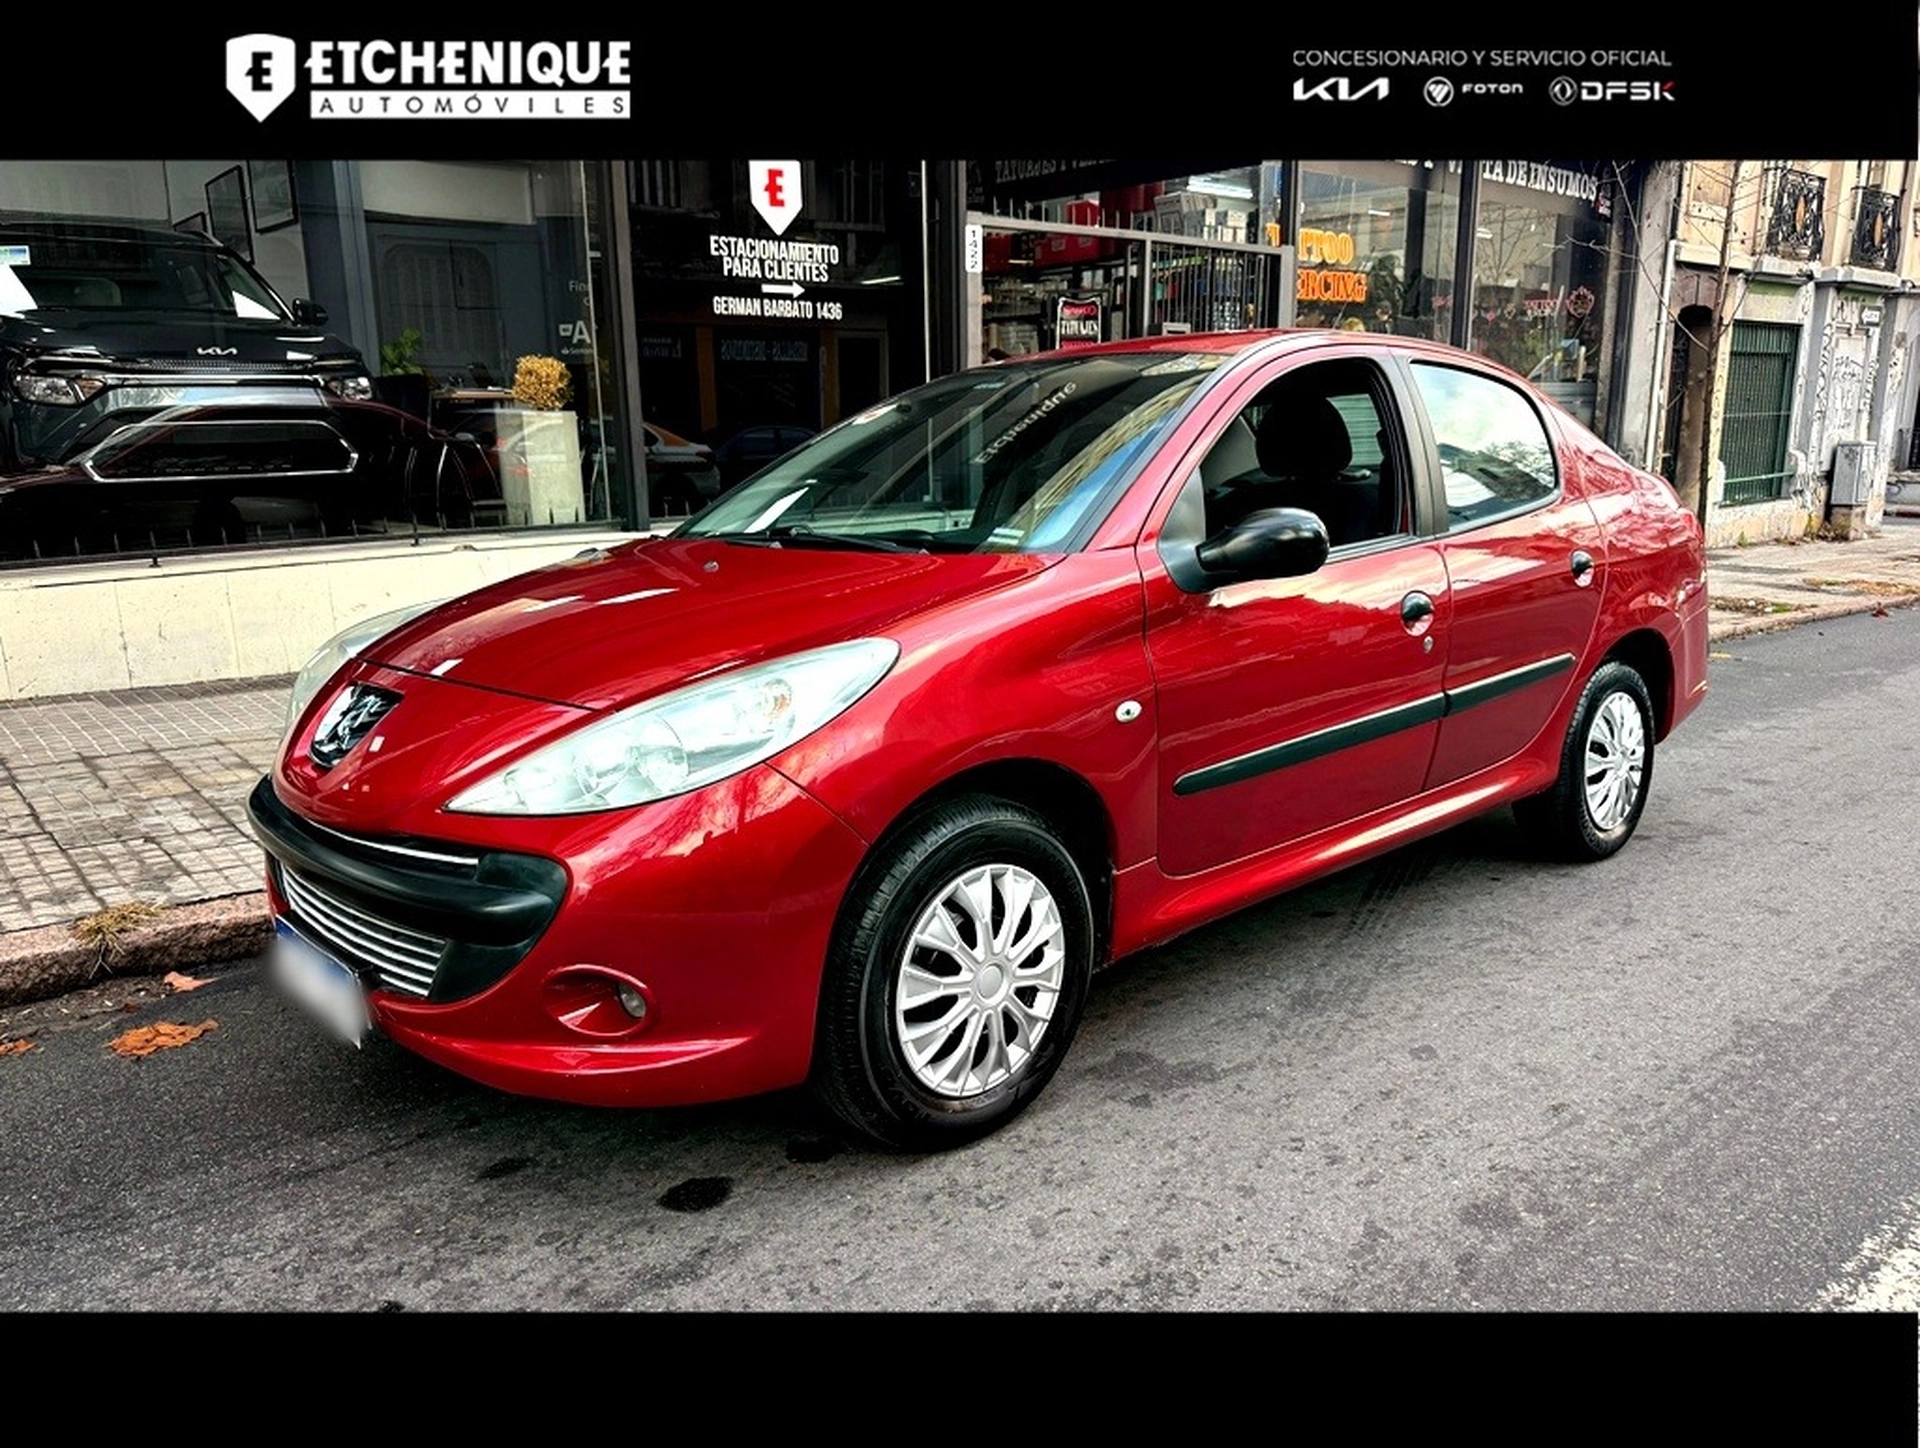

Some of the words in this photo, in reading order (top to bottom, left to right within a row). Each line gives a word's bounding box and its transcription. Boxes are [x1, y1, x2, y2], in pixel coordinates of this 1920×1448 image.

[1505, 161, 1528, 187] DE
[1527, 162, 1598, 202] INSUMOS
[709, 234, 840, 265] ESTACIONAMIENTO
[969, 229, 978, 269] 1422
[722, 256, 762, 279] PARA
[764, 259, 829, 282] CLIENTES
[713, 296, 761, 317] GERMAN
[762, 298, 813, 319] BARBATO
[815, 301, 843, 320] 1436
